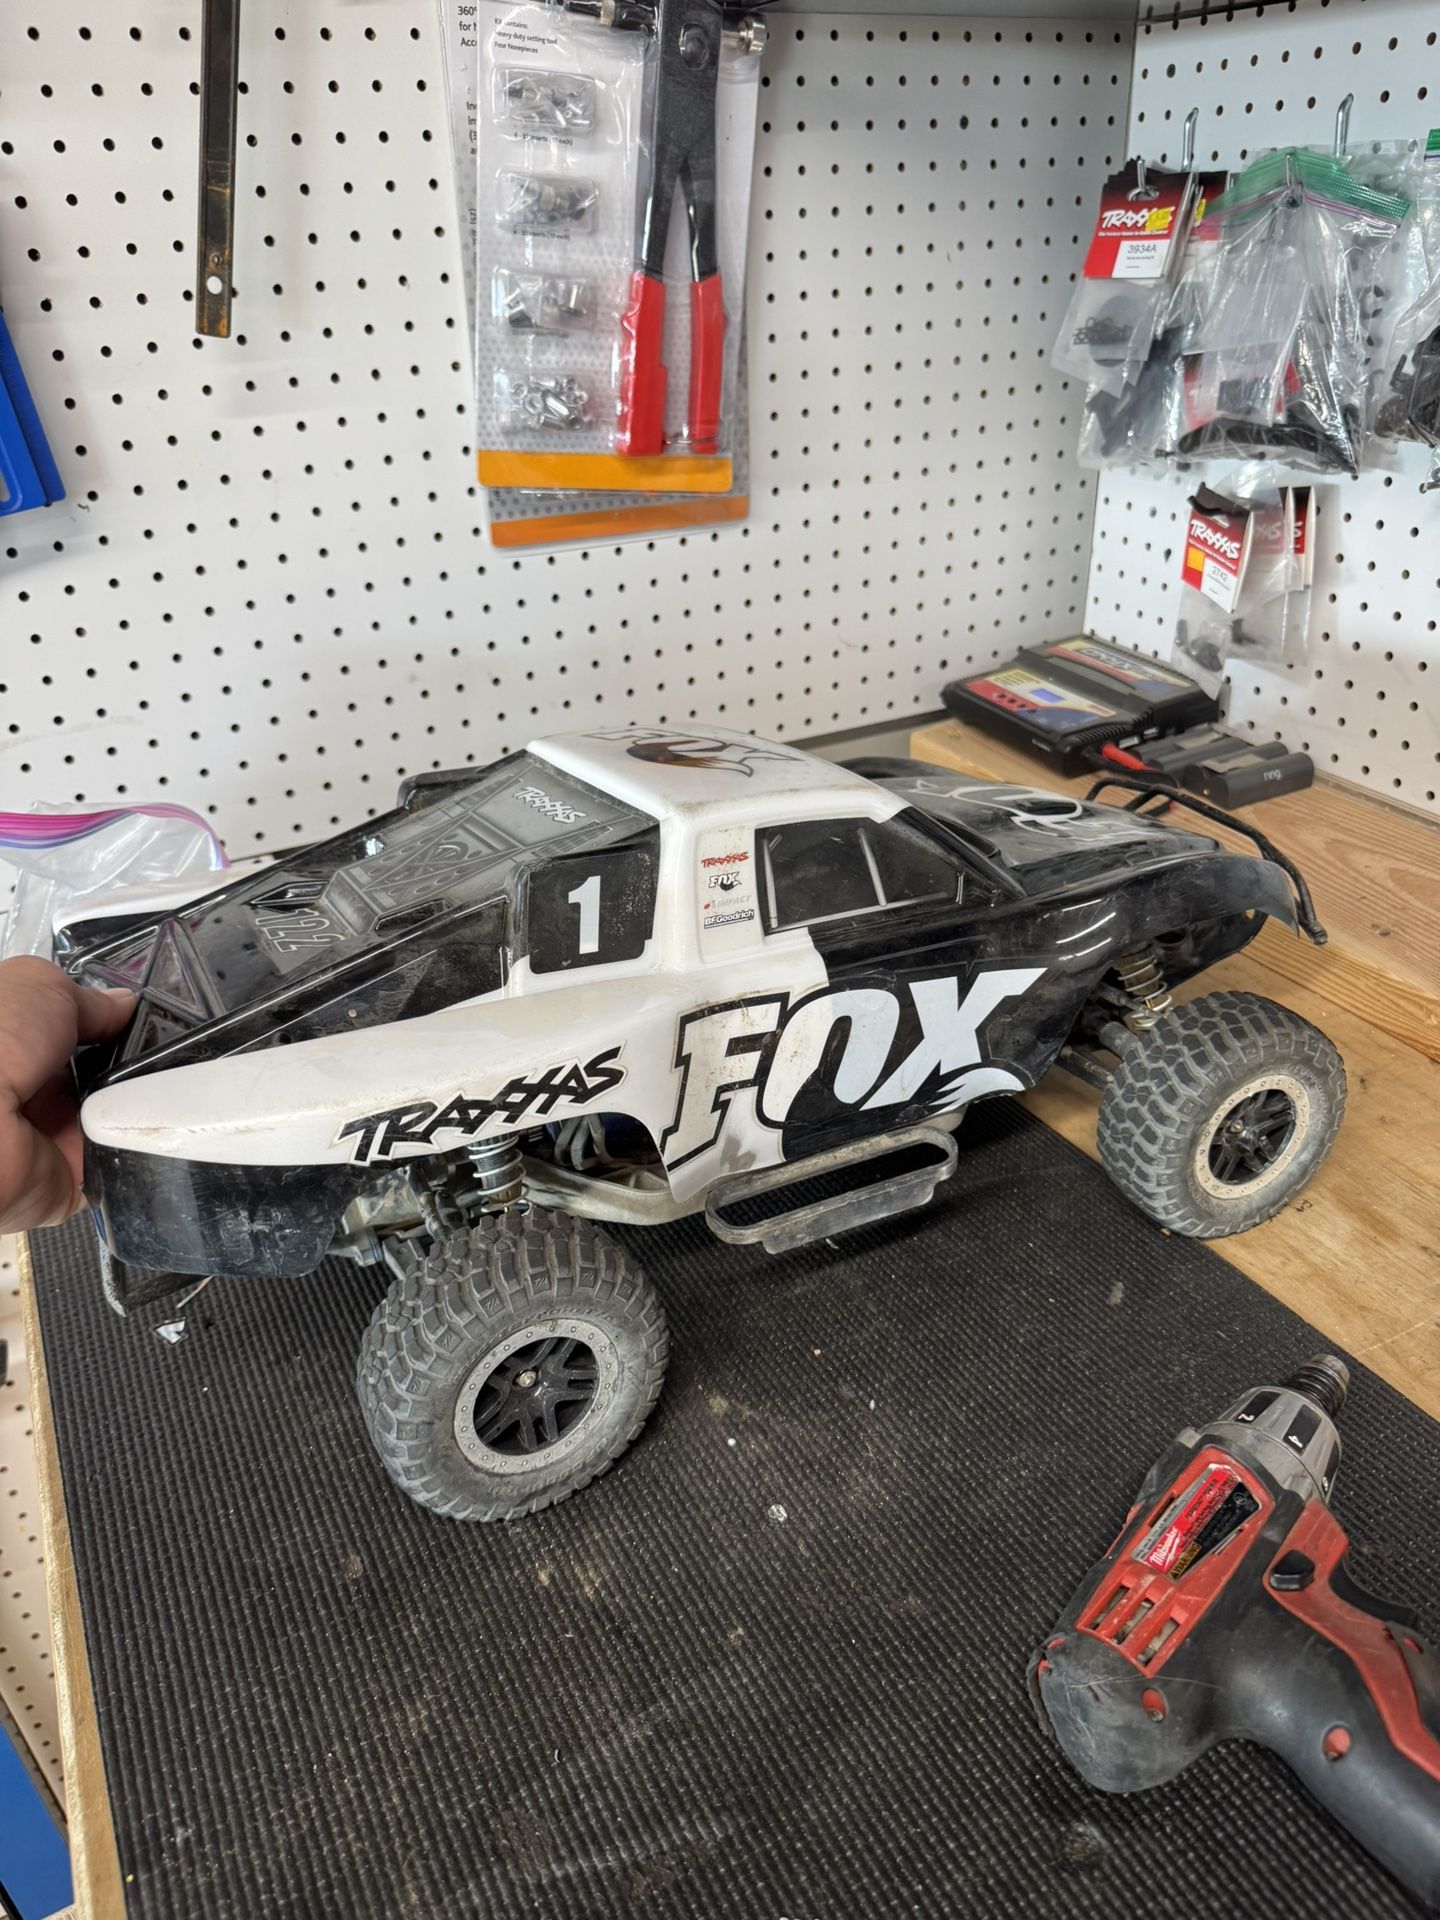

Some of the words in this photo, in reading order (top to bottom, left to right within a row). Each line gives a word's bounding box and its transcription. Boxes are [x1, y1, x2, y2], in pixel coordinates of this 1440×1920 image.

[459, 21, 471, 31] for
[495, 31, 512, 40] eavy
[513, 32, 526, 41] duty
[527, 35, 546, 44] setting
[508, 43, 539, 54] Nosepieces
[1190, 519, 1241, 560] TRAXXAS
[1263, 768, 1282, 782] ring
[512, 786, 588, 825] TRAXXAS
[701, 851, 749, 868] TRAXXAS
[708, 871, 743, 891] FOX
[567, 874, 601, 954] 1
[664, 967, 1048, 1172] FOX
[340, 1044, 625, 1164] TRAXXAS
[1288, 1435, 1303, 1448] 4
[1148, 1525, 1179, 1567] Milwaukee
[1173, 1541, 1202, 1574] WARNING
